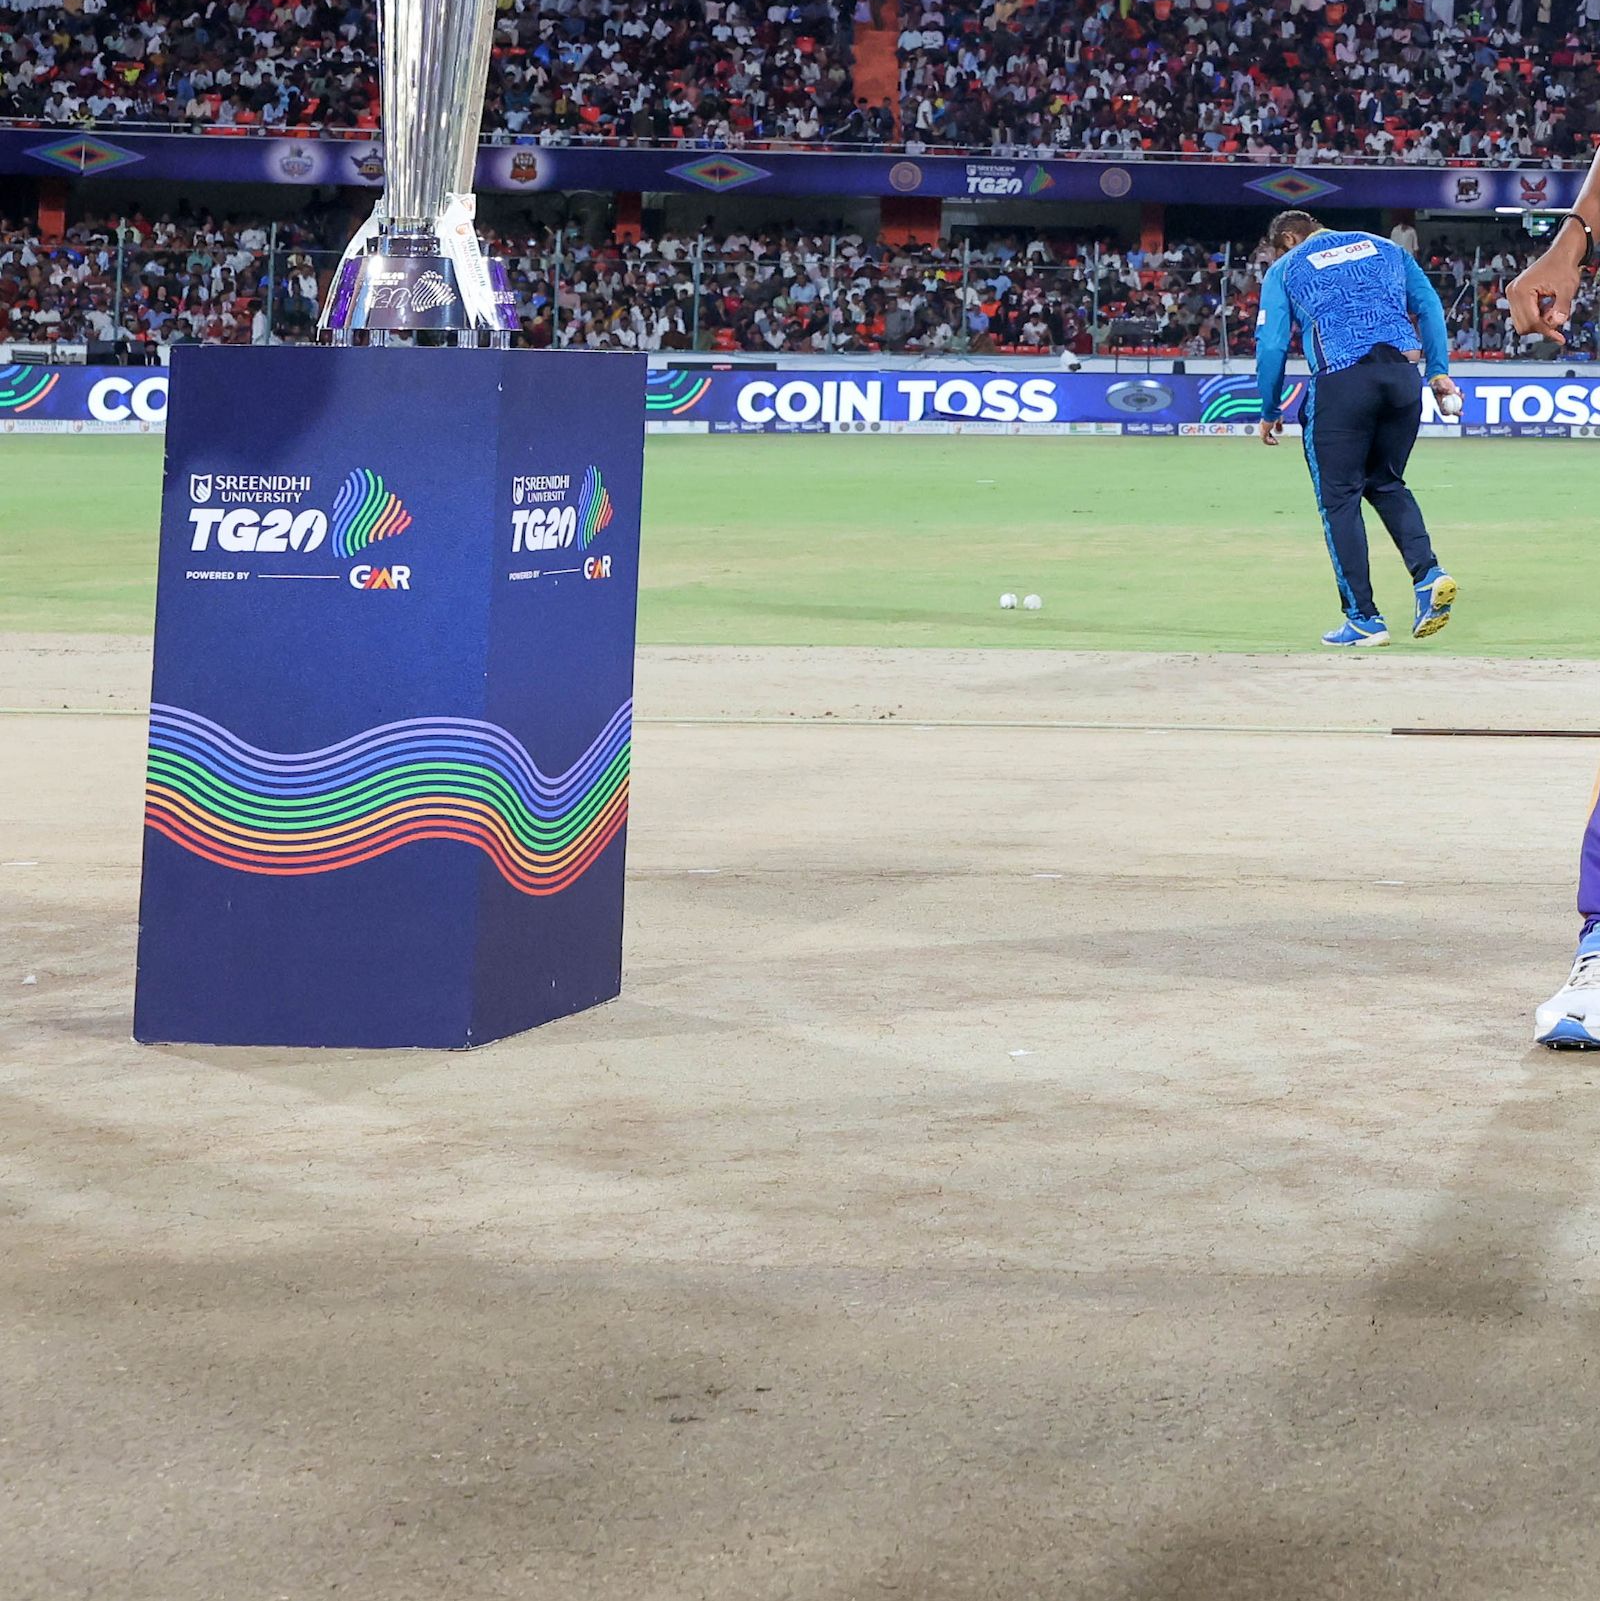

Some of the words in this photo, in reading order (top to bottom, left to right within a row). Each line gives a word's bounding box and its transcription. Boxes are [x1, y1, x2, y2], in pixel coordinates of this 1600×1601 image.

[966, 177, 1022, 195] TG20
[737, 380, 882, 423] COIN
[898, 379, 1058, 422] TOSS
[214, 475, 311, 491] SREENIDHI
[525, 475, 570, 491] SREENIDHI
[221, 492, 302, 503] UNIVERSITY
[527, 490, 566, 503] UNIVERSITY
[188, 508, 328, 553] TG20
[512, 506, 577, 553] TG20
[186, 571, 235, 580] POWERED
[237, 571, 250, 580] BY
[509, 570, 533, 581] POWERED
[584, 555, 612, 580] GMR
[349, 565, 411, 590] GMR
